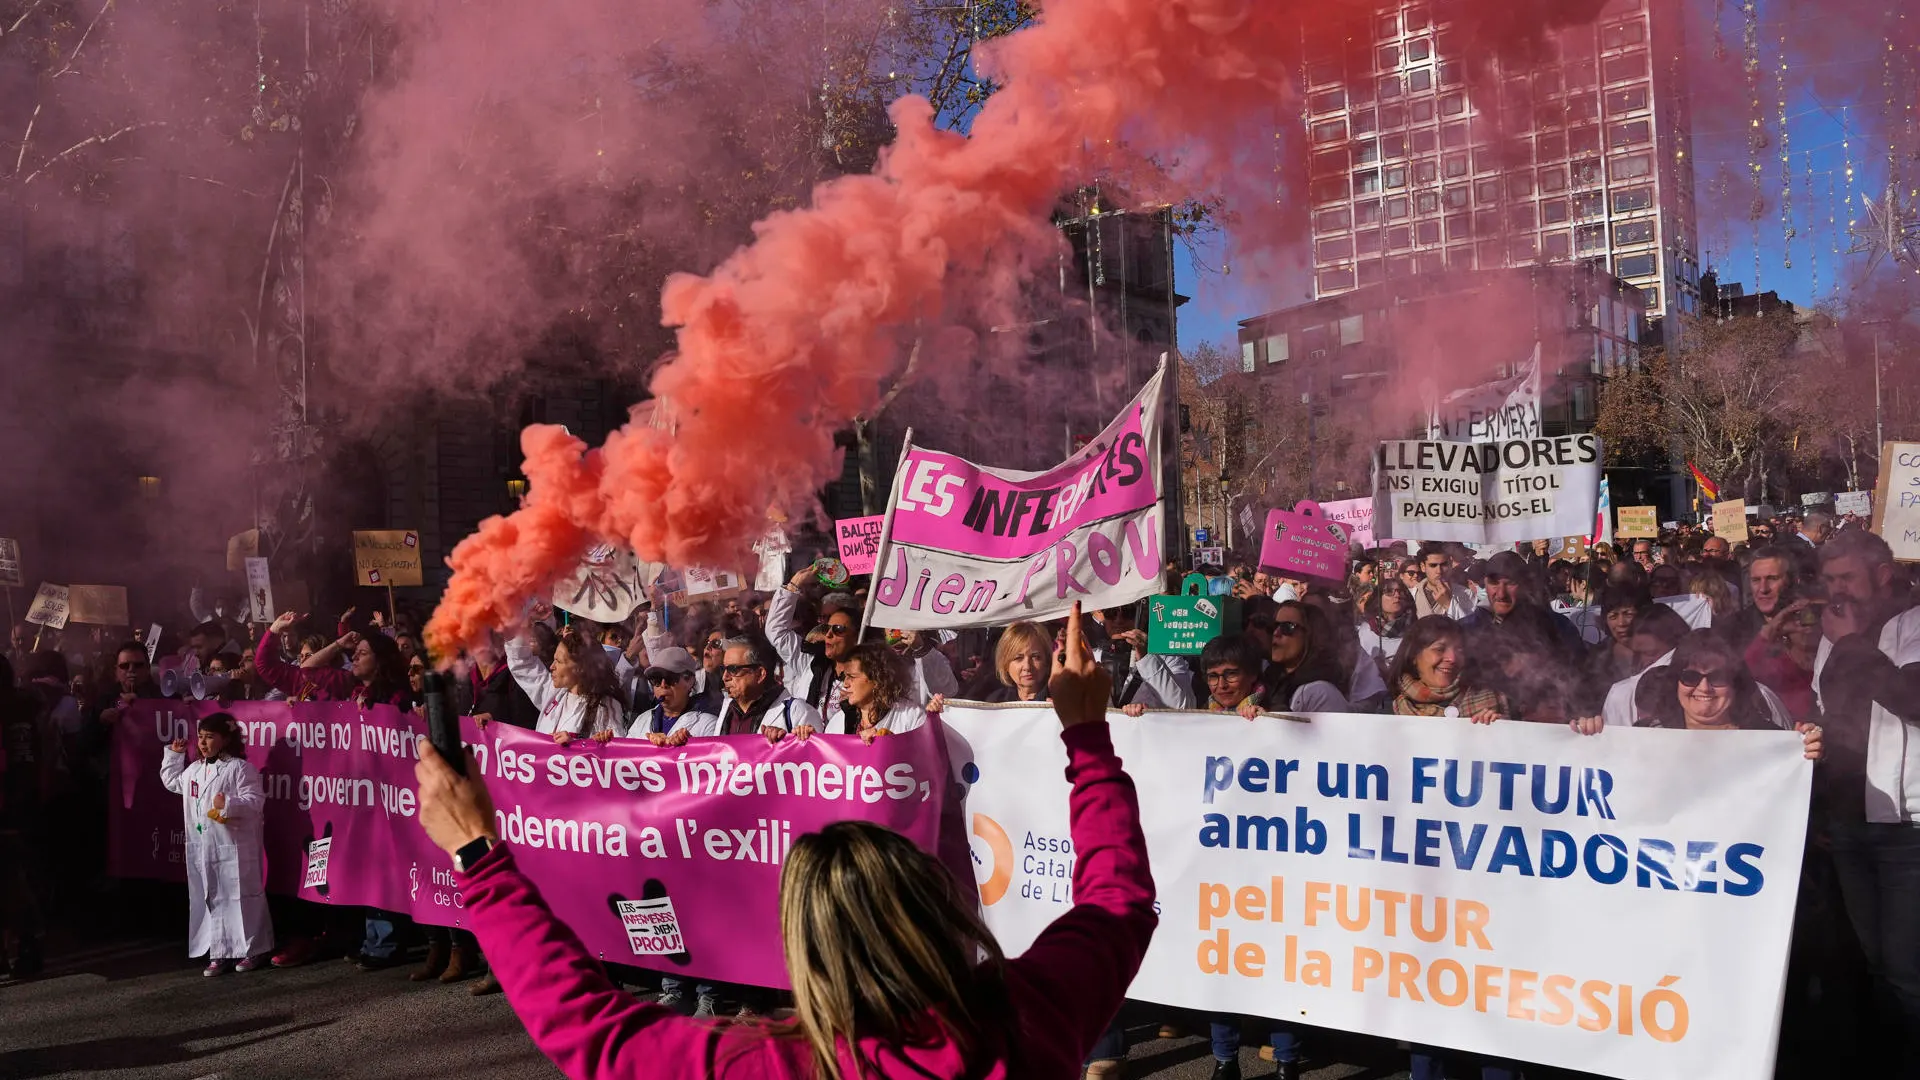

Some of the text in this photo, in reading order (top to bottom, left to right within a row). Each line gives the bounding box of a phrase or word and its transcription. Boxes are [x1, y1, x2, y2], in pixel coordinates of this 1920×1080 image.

[1380, 435, 1597, 474] LLEVADORES
[896, 459, 969, 518] LES
[1422, 477, 1479, 496] EXIGIU
[1503, 474, 1560, 494] TÍTOL
[1331, 508, 1372, 521] Les LLEVA
[1403, 498, 1552, 520] PAGUEU-NOS-EL
[876, 547, 998, 615] diem
[1016, 514, 1160, 609] PROU
[41, 600, 65, 612] SENSE
[155, 710, 188, 742] Un
[285, 720, 329, 756] que
[331, 723, 351, 750] no
[495, 738, 536, 784] les
[547, 753, 666, 792] seves
[677, 752, 931, 804] infermeres,
[1202, 756, 1616, 820] per un FUTUR
[299, 774, 374, 811] govern
[381, 782, 416, 820] que
[640, 827, 668, 859] a
[1199, 806, 1765, 897] amb LLEVADORES
[434, 890, 451, 907] de
[1021, 880, 1043, 900] de
[619, 903, 636, 914] LES
[1199, 876, 1494, 951] pel FUTUR
[632, 934, 683, 952] PROU!
[652, 923, 678, 936] DIEM
[1197, 929, 1690, 1043] de la PROFESSIÓ
